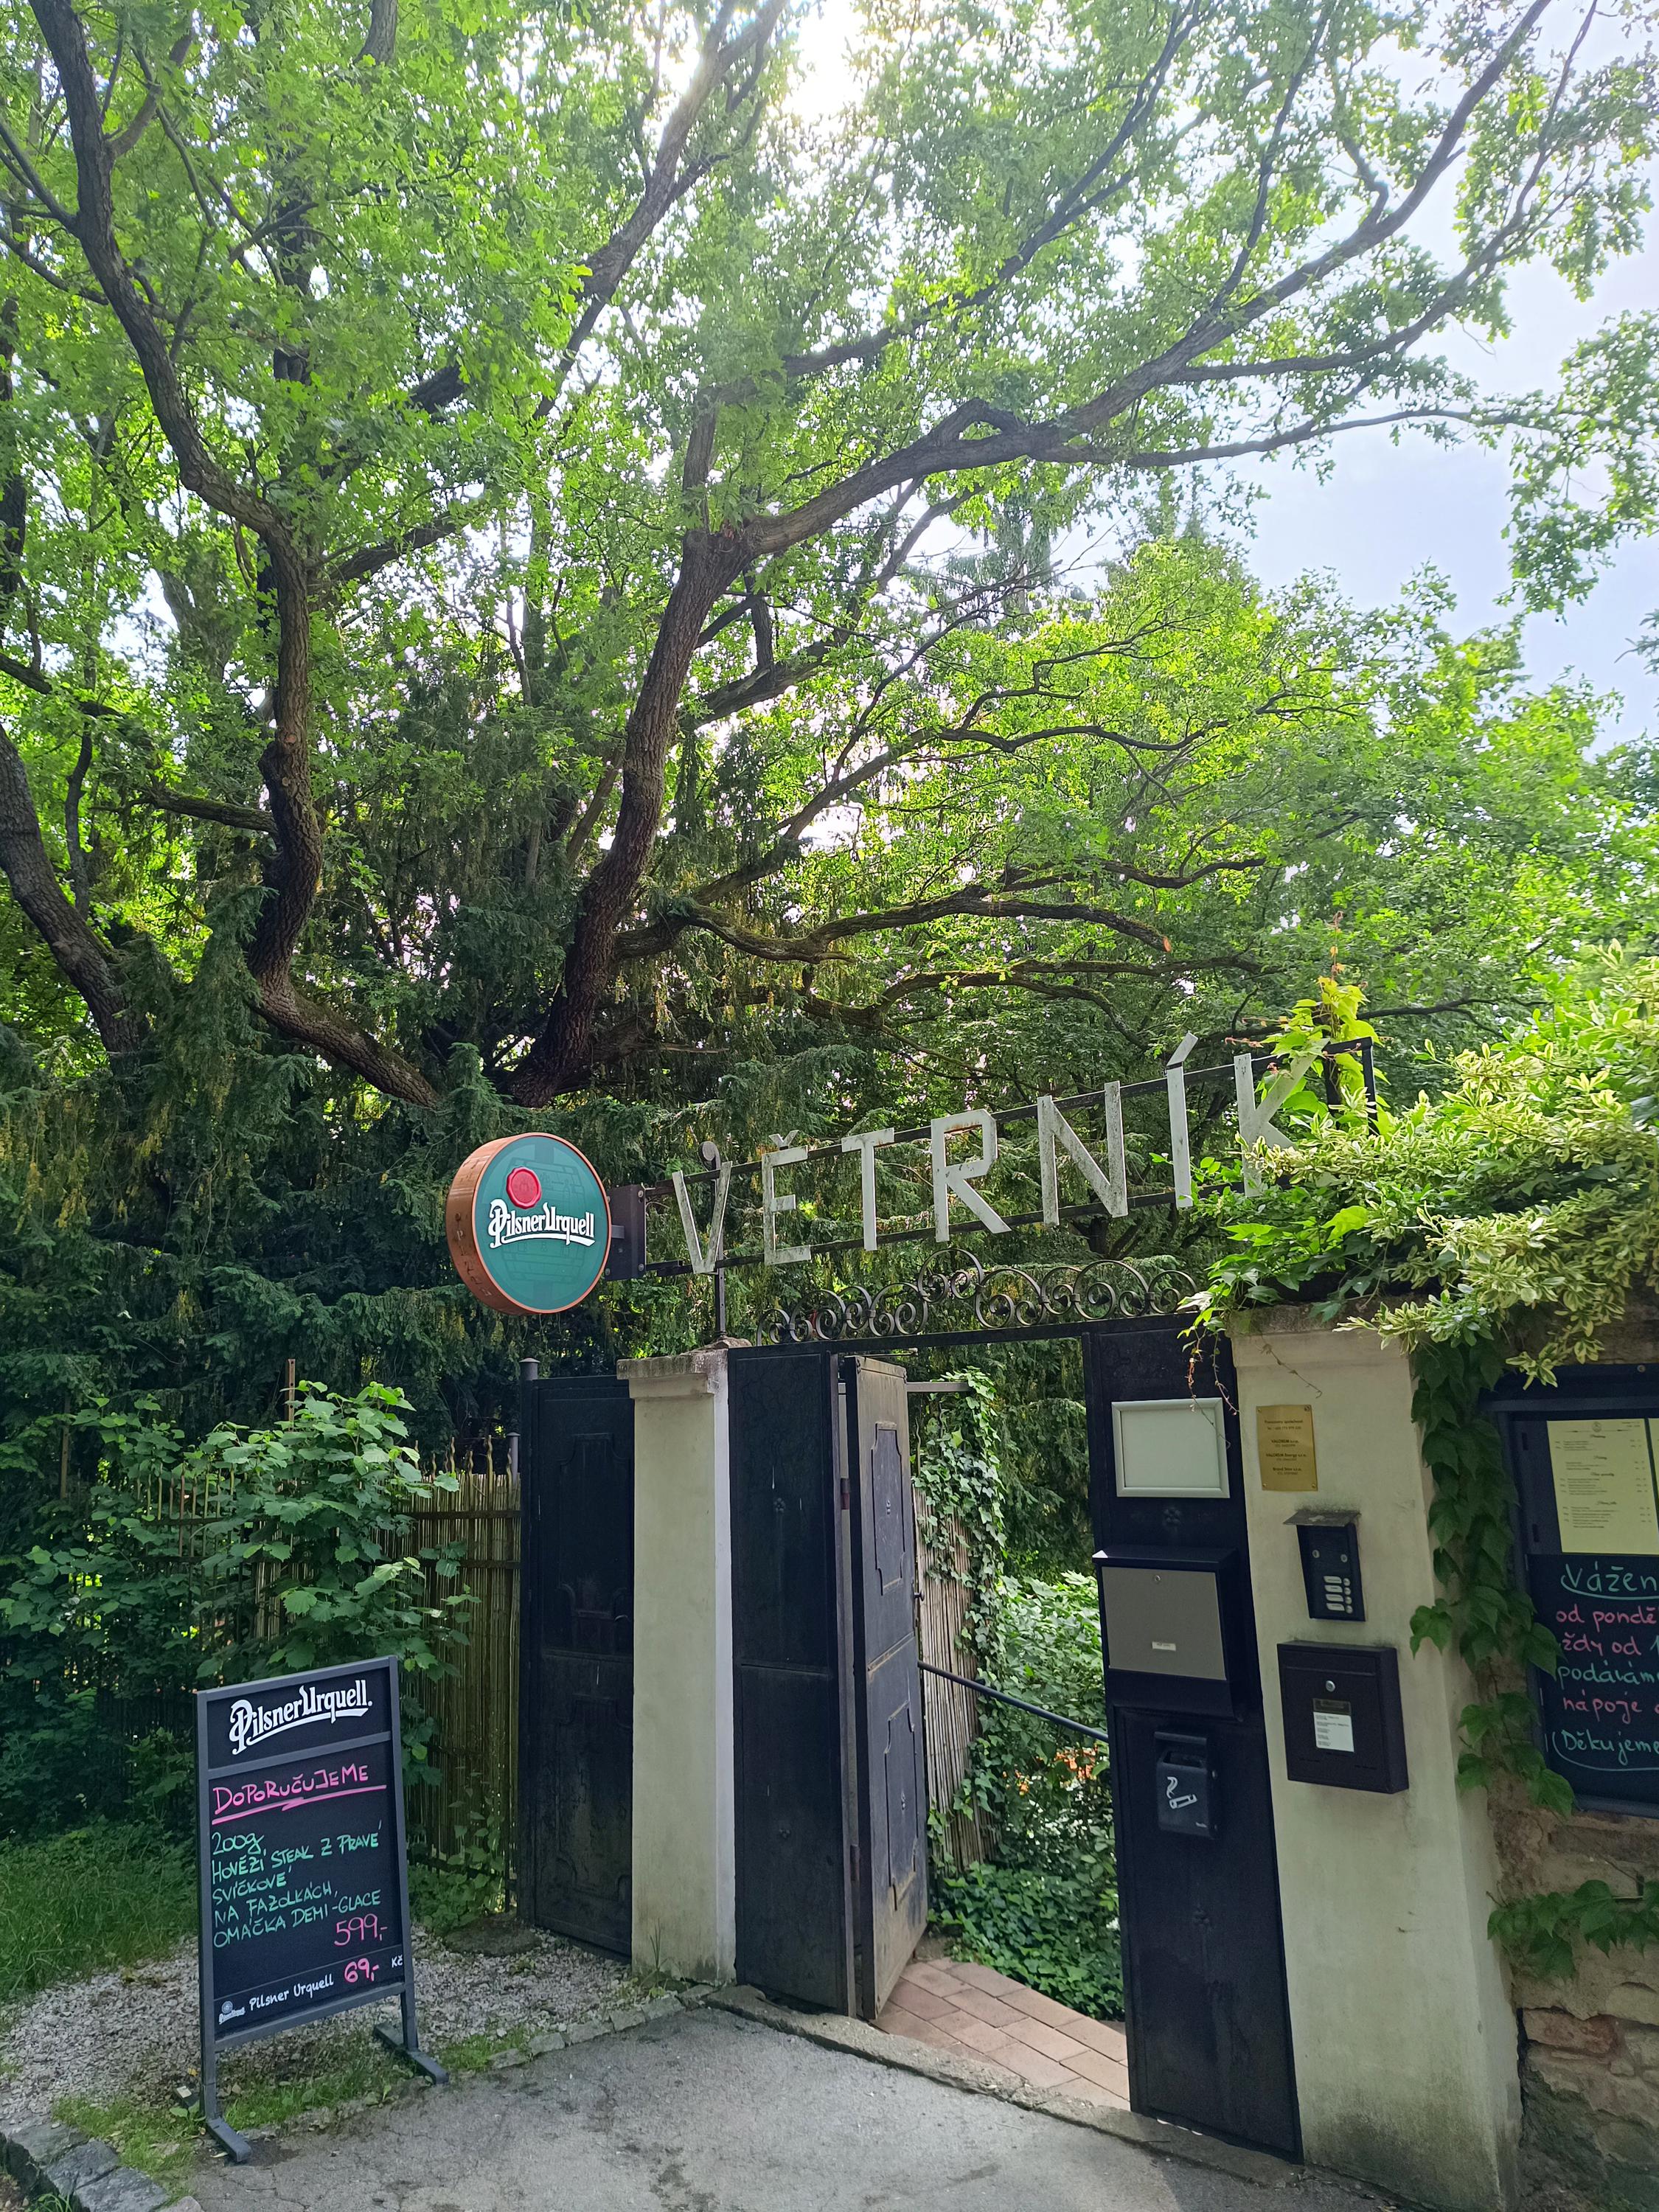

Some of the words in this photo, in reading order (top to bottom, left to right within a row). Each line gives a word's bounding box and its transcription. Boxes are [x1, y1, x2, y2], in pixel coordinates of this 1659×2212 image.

[672, 1032, 1330, 1274] VĚTRNÍK
[487, 1198, 545, 1249] Pilsner
[543, 1202, 595, 1246] Urquell
[1556, 1603, 1585, 1623] od
[1593, 1605, 1659, 1632] pondě
[1558, 1632, 1604, 1657] ždy
[1612, 1635, 1642, 1656] od
[1557, 1659, 1659, 1690] podávám
[1563, 1688, 1643, 1724] nápoje
[229, 1699, 302, 1755] Pilsner
[271, 1846, 314, 1868] STEAK
[320, 1837, 333, 1856] Z
[336, 1819, 382, 1854] PRAVÉ
[212, 1865, 292, 1905] SVÍČKOVÉ
[213, 1916, 286, 1948] OMÁČKA
[215, 1905, 239, 1928] NA
[249, 1990, 290, 2011] Pilsner
[293, 1973, 334, 1999] Urquell
[392, 1955, 403, 1968] Kč
